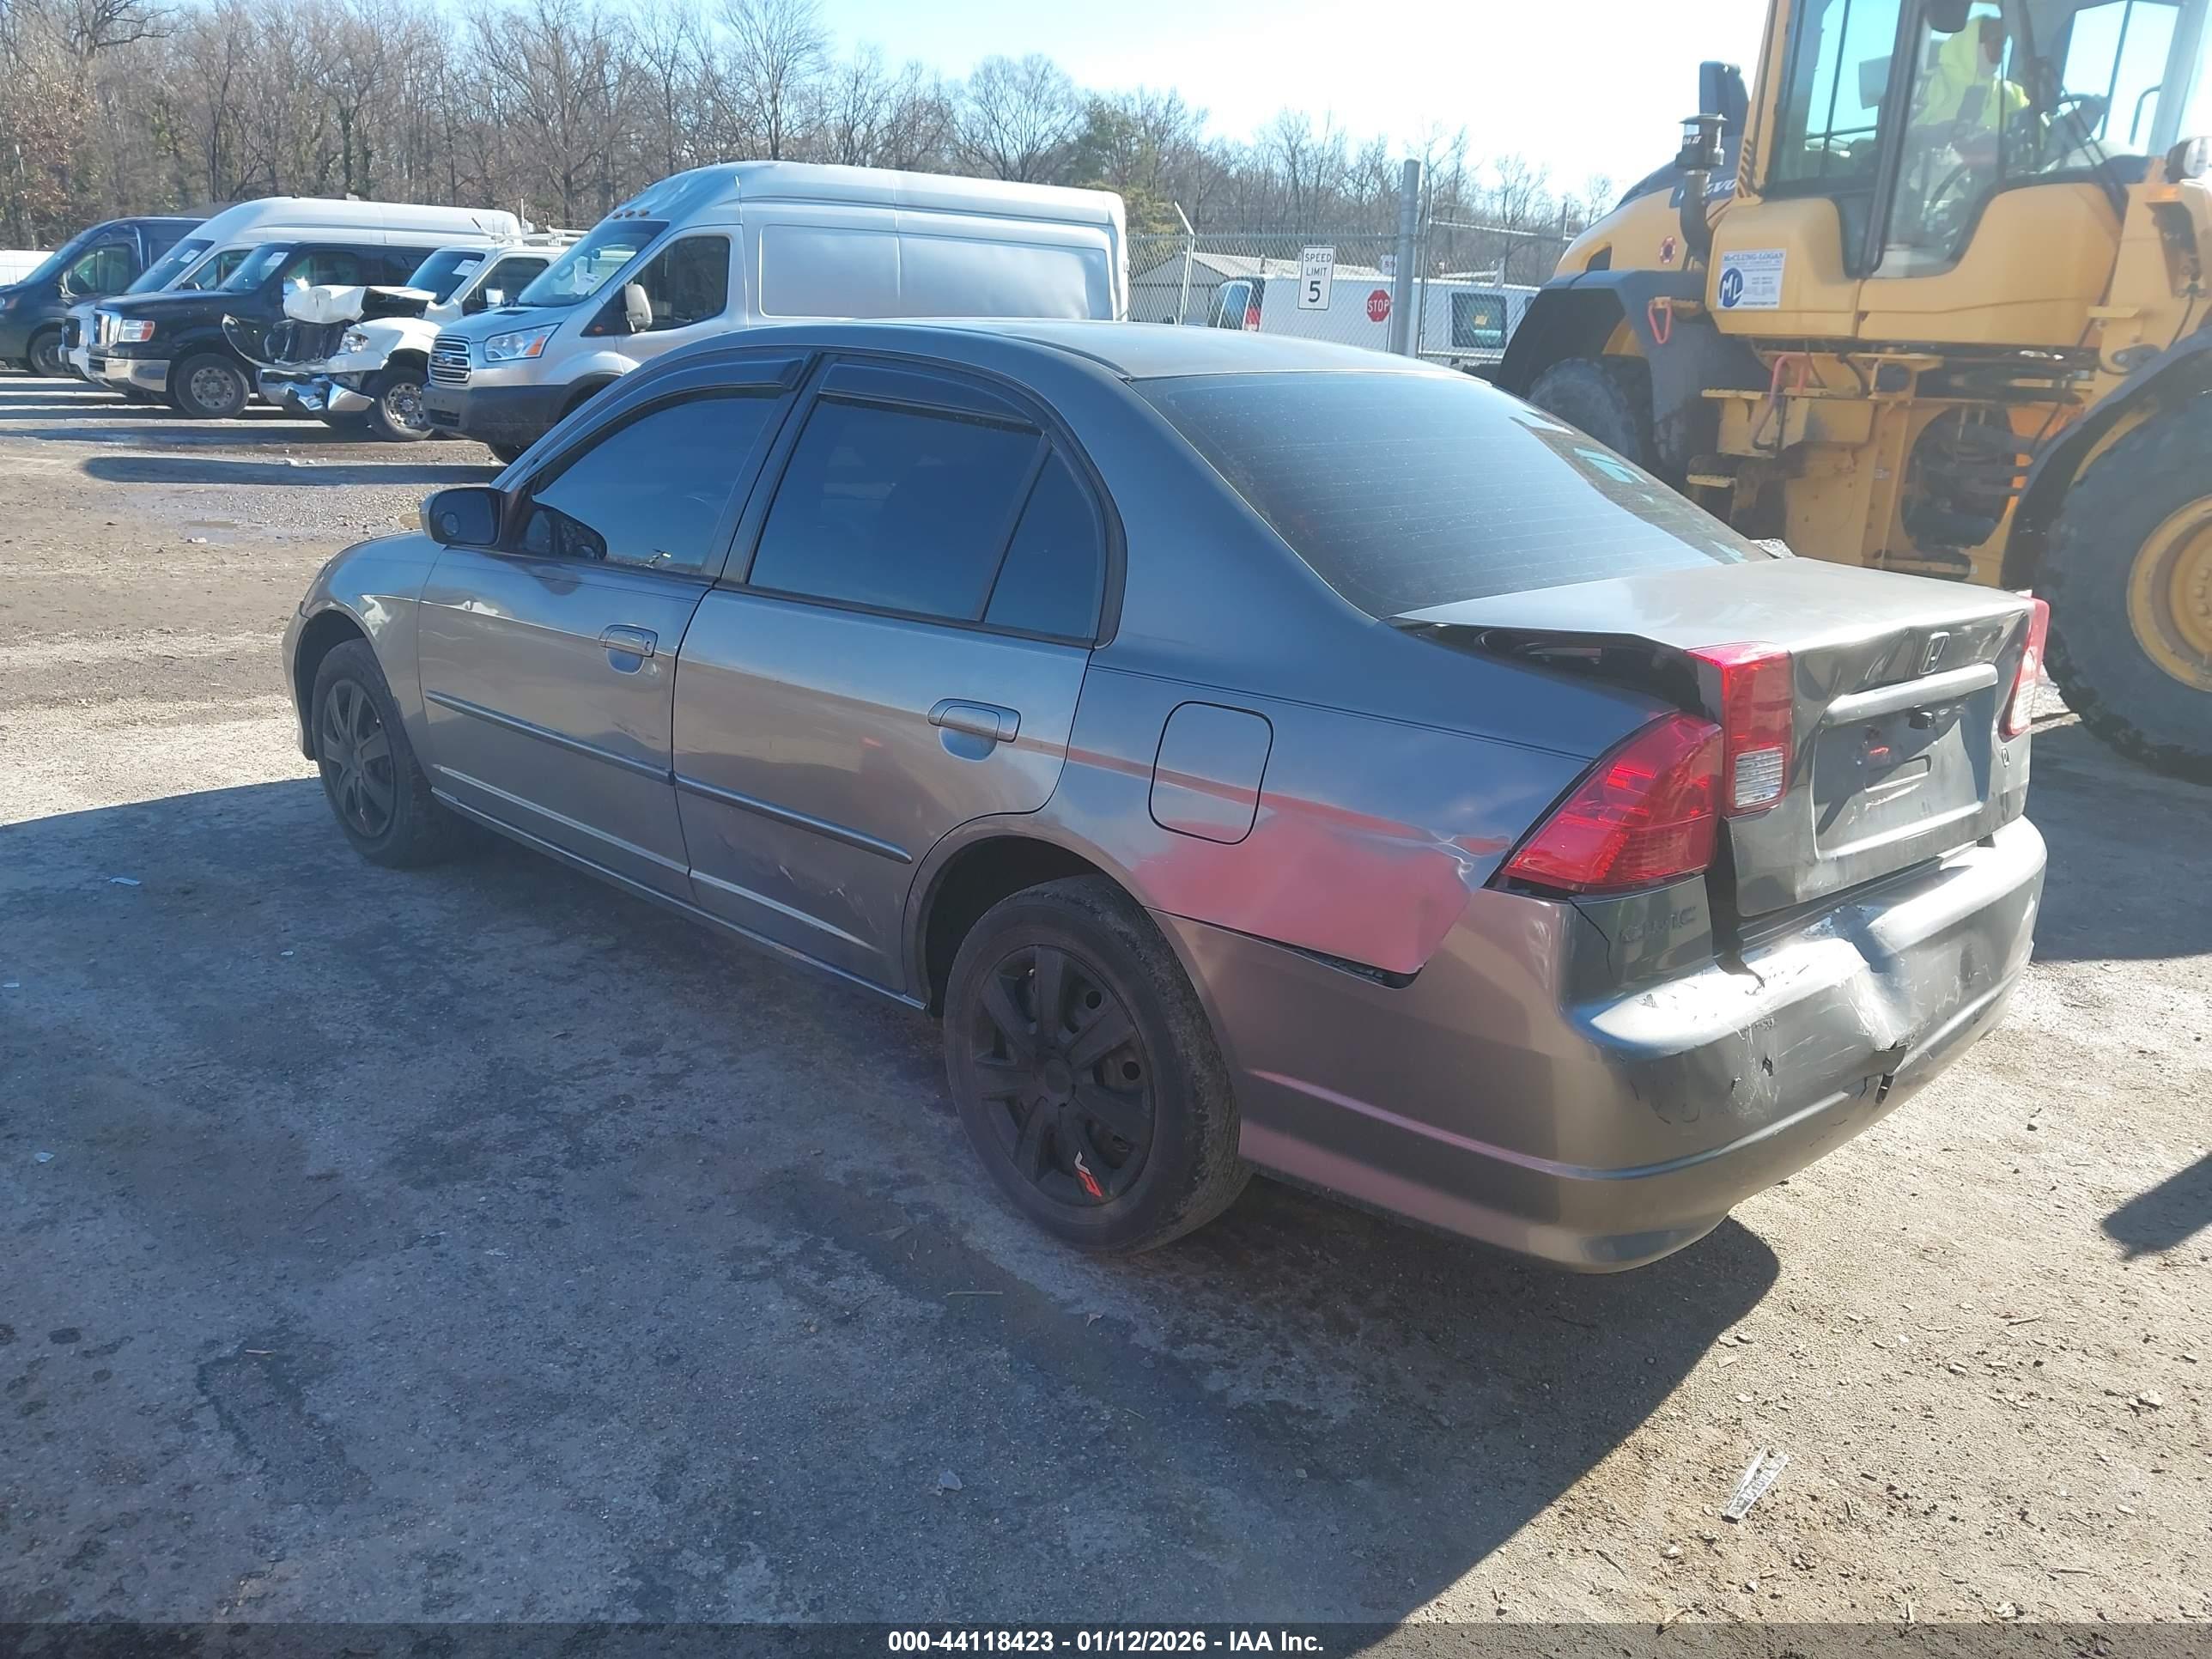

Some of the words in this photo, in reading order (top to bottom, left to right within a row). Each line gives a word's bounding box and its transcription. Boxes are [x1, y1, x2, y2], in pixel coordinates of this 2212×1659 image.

[1304, 253, 1332, 263] SPEED
[1306, 267, 1328, 276] LIMIT
[1308, 280, 1321, 303] 5
[1367, 300, 1389, 313] STOP
